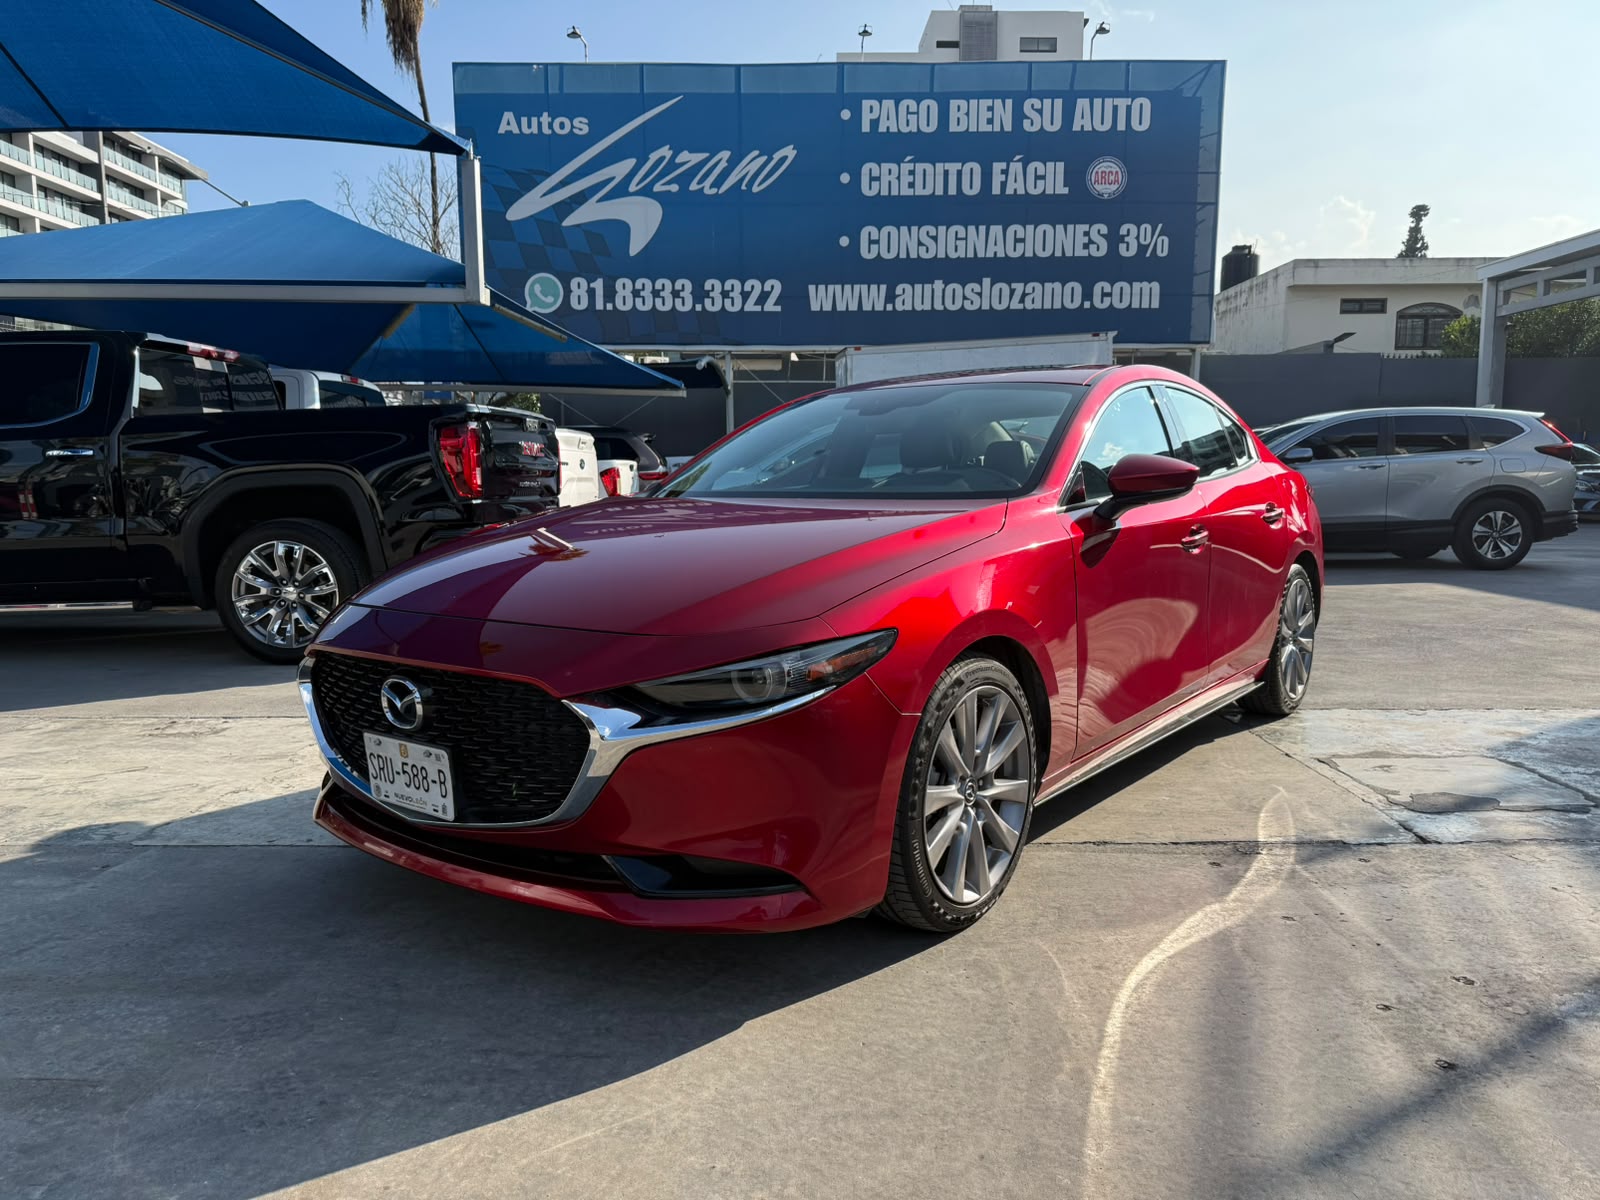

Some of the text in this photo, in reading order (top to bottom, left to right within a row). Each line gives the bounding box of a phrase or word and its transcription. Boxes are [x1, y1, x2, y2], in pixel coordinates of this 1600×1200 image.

[497, 111, 590, 135] Autos
[861, 97, 1152, 134] PAGO BIEN SU AUTO
[505, 95, 798, 257] Lozano
[860, 155, 1069, 197] CRÉDITO FÁCIL
[1093, 170, 1120, 186] ARCA
[859, 223, 1170, 260] CONSIGNACIONES 3%
[569, 276, 782, 313] 81.8333.3322
[808, 277, 1161, 312] www.autoslozano.com
[369, 753, 447, 799] SRU-588-B
